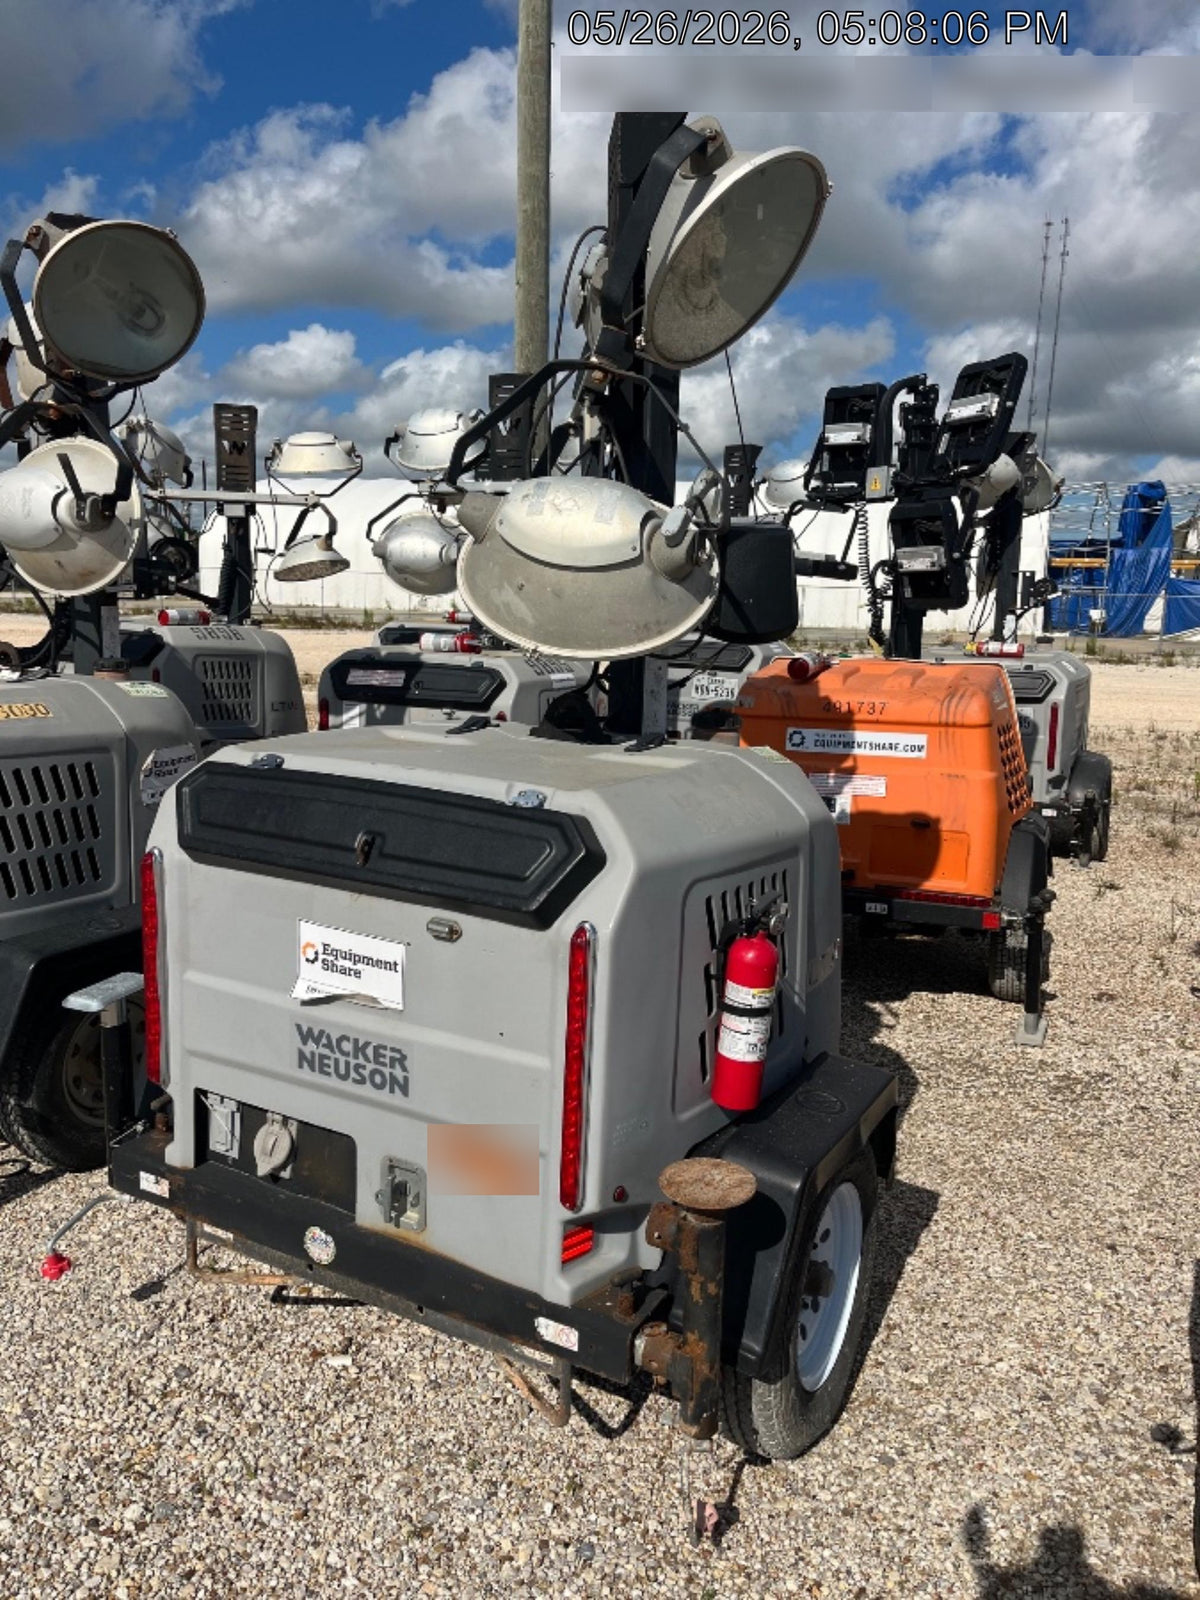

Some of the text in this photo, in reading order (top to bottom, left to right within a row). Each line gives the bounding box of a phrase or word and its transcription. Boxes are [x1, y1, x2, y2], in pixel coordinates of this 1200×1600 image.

[823, 701, 888, 716] 491737
[813, 738, 926, 753] EQUIPMENTSHARE.COM
[321, 942, 399, 974] Equipment
[321, 957, 363, 979] Share
[295, 1022, 409, 1073] WACKER
[297, 1047, 410, 1098] NEUSON
